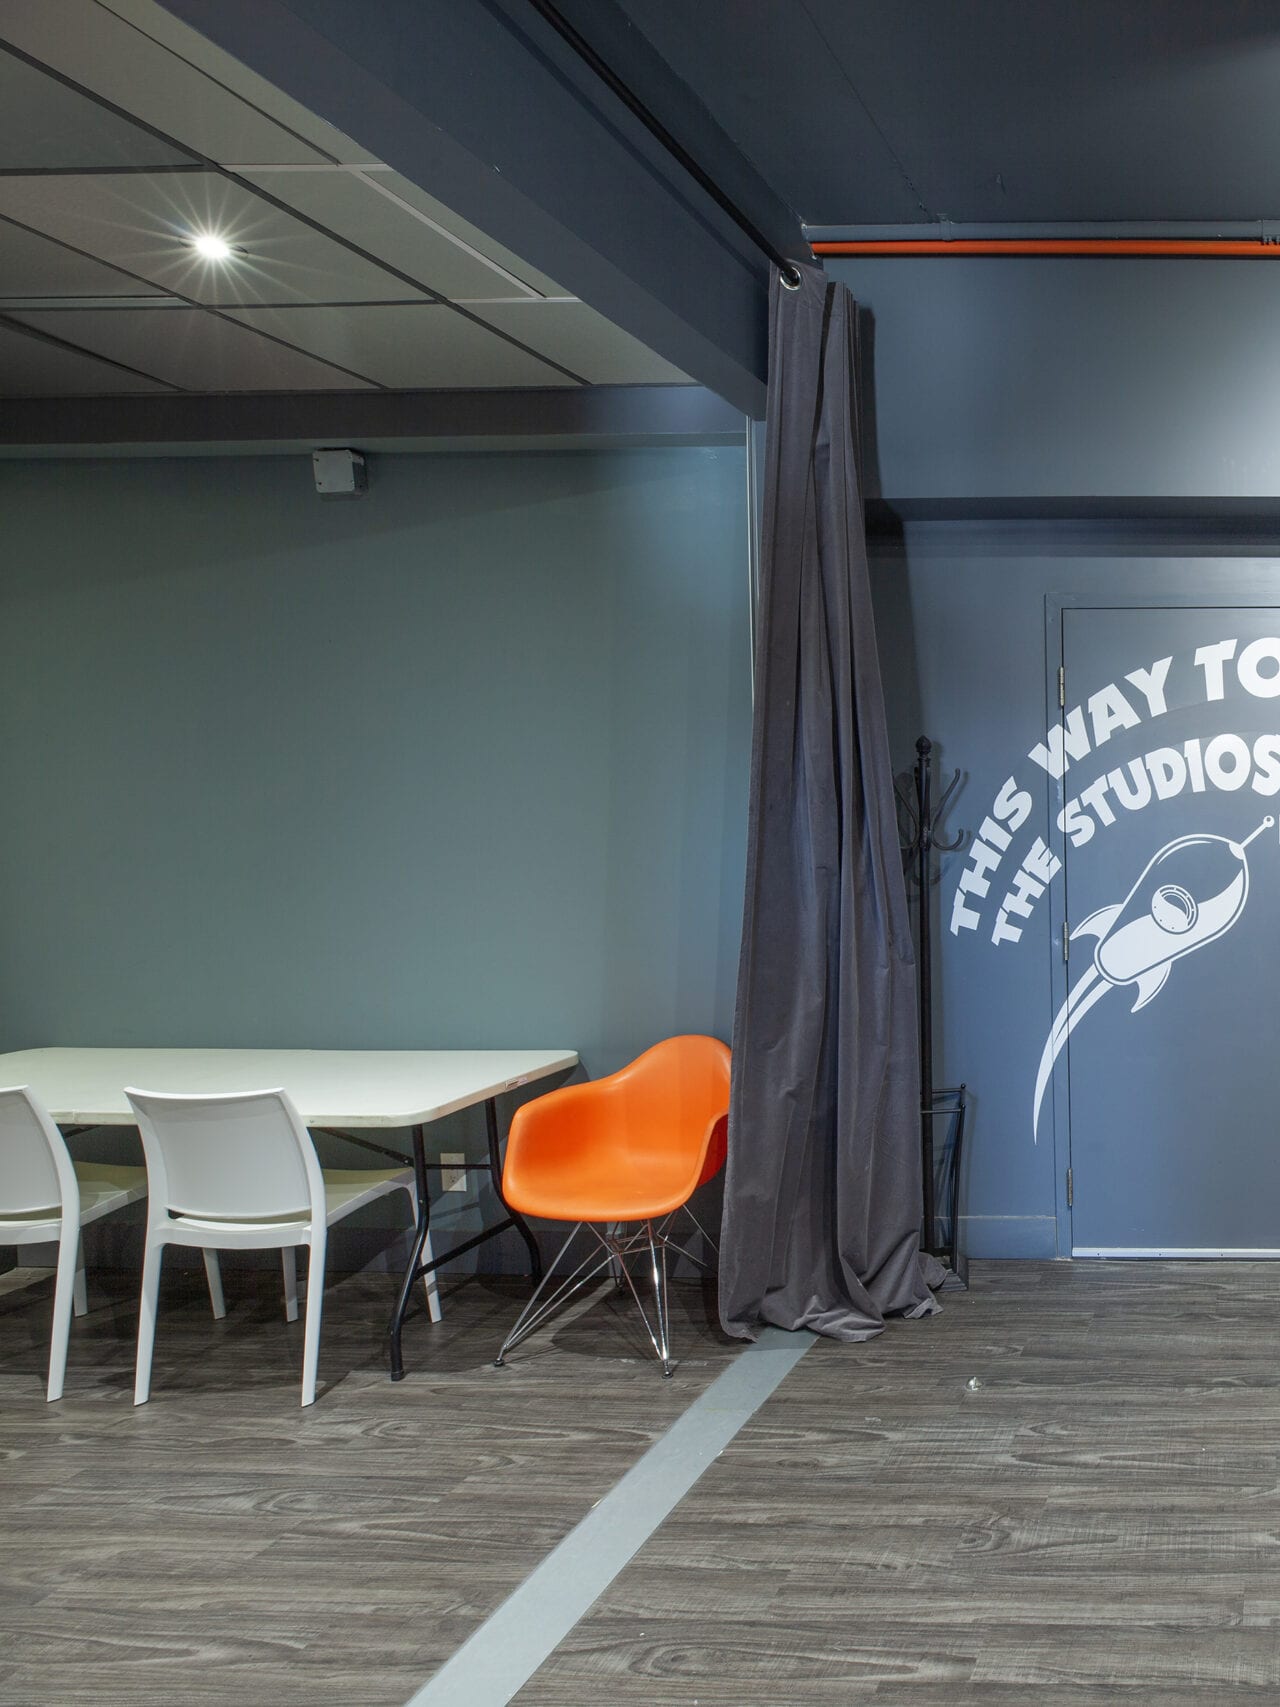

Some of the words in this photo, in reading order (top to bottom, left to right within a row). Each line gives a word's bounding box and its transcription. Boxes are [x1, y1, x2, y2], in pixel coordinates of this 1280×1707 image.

[950, 775, 1033, 936] THIS
[1027, 655, 1173, 780] WAY
[991, 836, 1063, 946] THE
